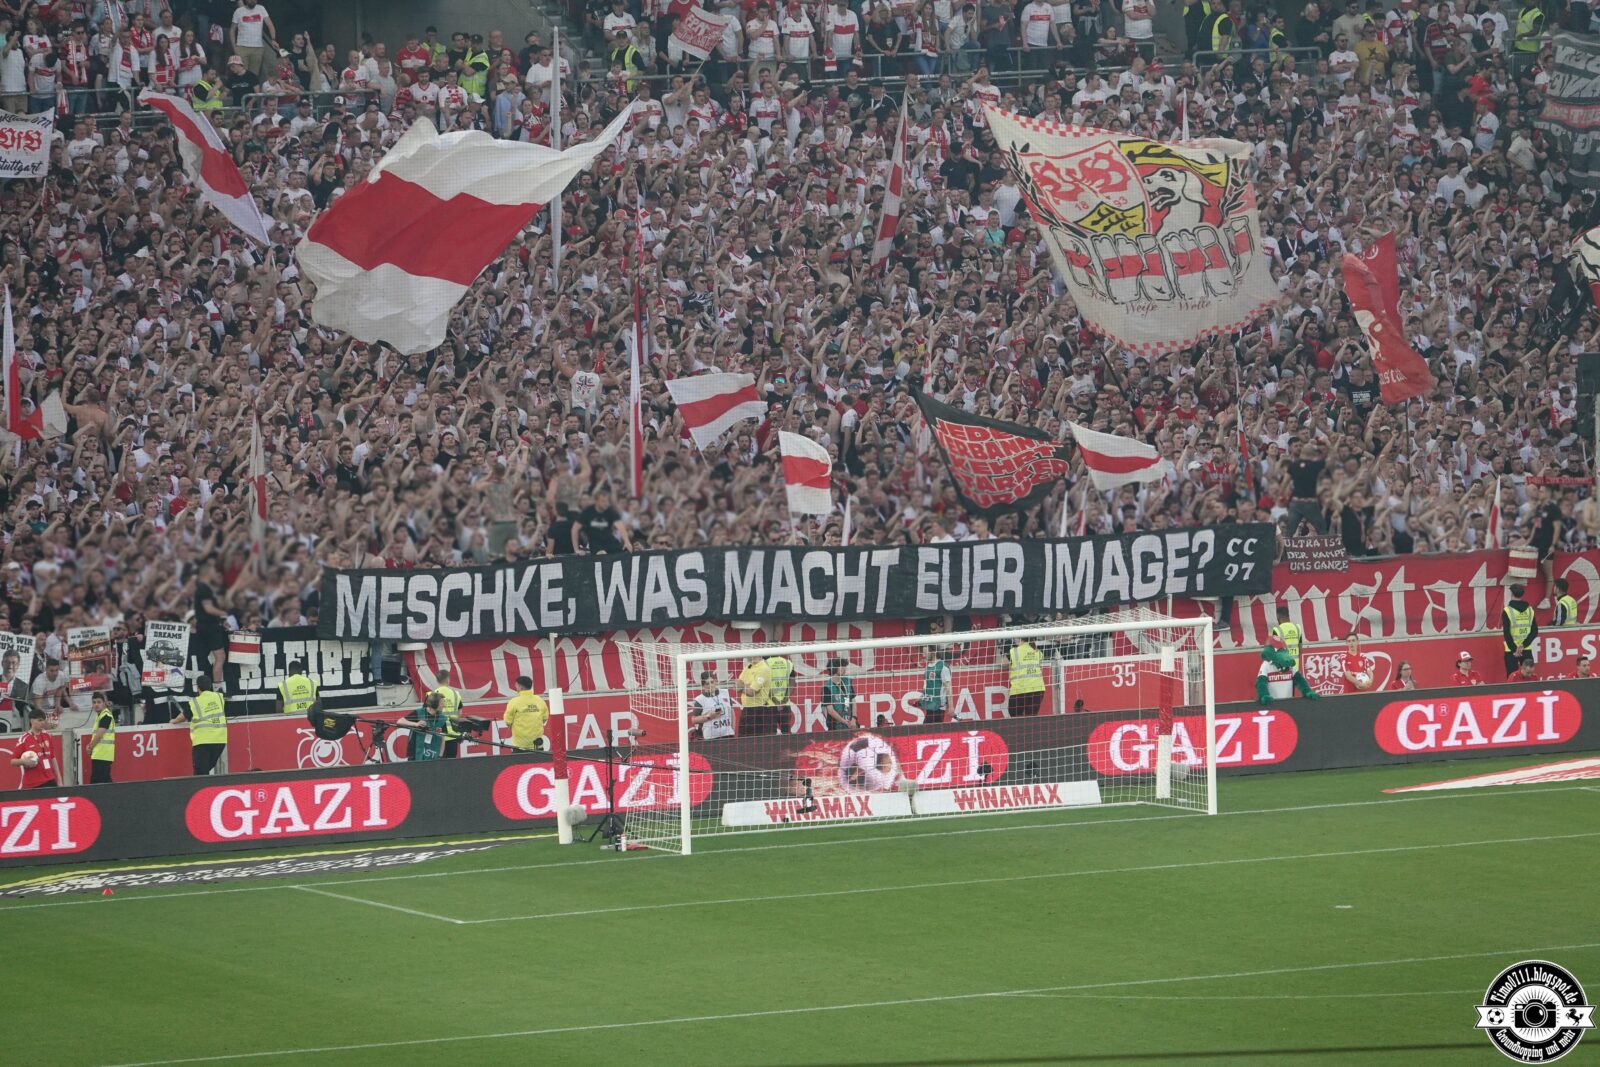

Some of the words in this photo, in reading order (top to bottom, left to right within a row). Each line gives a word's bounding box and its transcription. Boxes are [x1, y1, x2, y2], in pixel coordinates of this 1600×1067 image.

[1075, 200, 1089, 210] 18
[1226, 538, 1258, 557] CC
[1224, 562, 1255, 581] 97
[335, 562, 577, 640] MESCHKE,
[594, 551, 709, 624] WAS
[722, 548, 900, 616] MACHT
[916, 542, 1024, 612] EUER
[1043, 529, 1216, 609] IMAGE?
[151, 623, 176, 631] DRIVEN
[154, 632, 182, 640] DREAMS
[1111, 663, 1137, 688] 35
[132, 733, 159, 758] 34
[764, 795, 873, 822] WINAMAX
[954, 784, 1063, 811] WINAMAX
